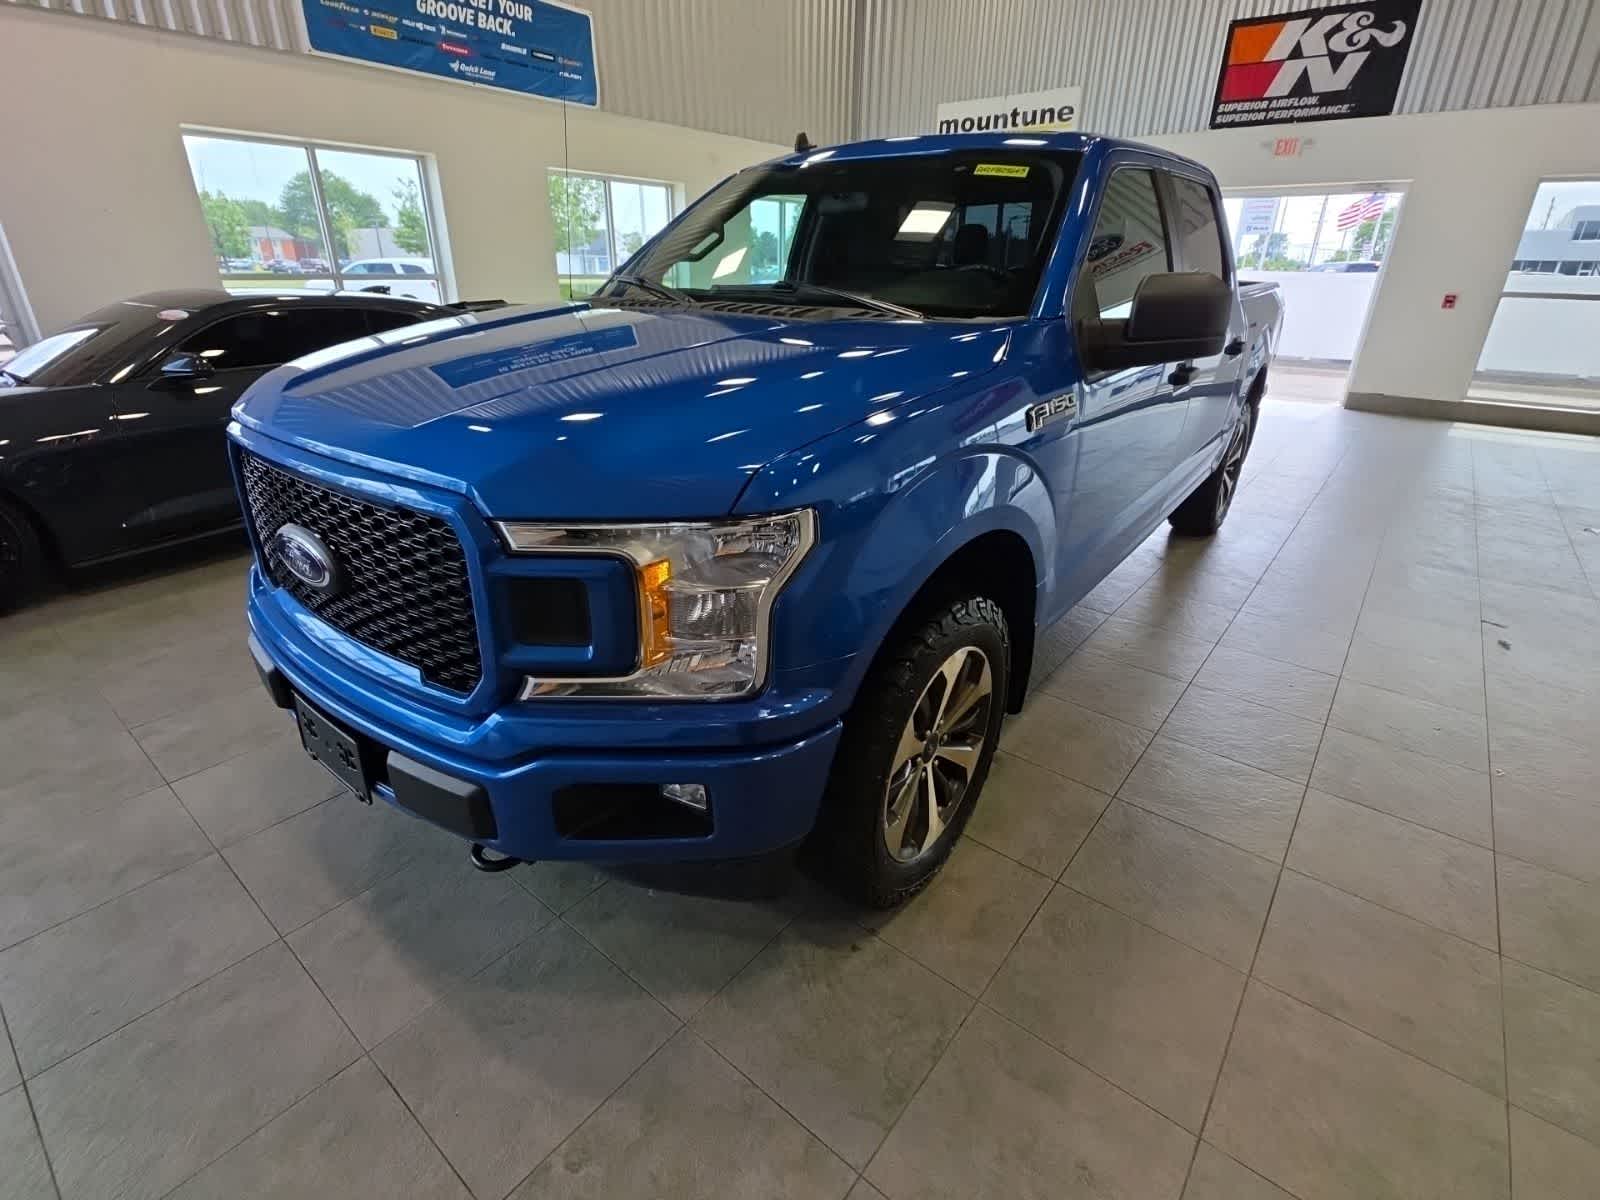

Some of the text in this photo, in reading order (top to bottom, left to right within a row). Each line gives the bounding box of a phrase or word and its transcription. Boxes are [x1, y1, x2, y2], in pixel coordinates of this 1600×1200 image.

[415, 0, 475, 26] GROOVE
[477, 11, 516, 38] BACK.
[498, 0, 533, 23] YOUR
[459, 63, 480, 73] Quick
[1217, 95, 1320, 113] SUPERIOR AIRFLOW.
[939, 104, 1074, 135] mountune
[1215, 109, 1265, 124] SUPERIOR
[1274, 137, 1299, 156] EXIT
